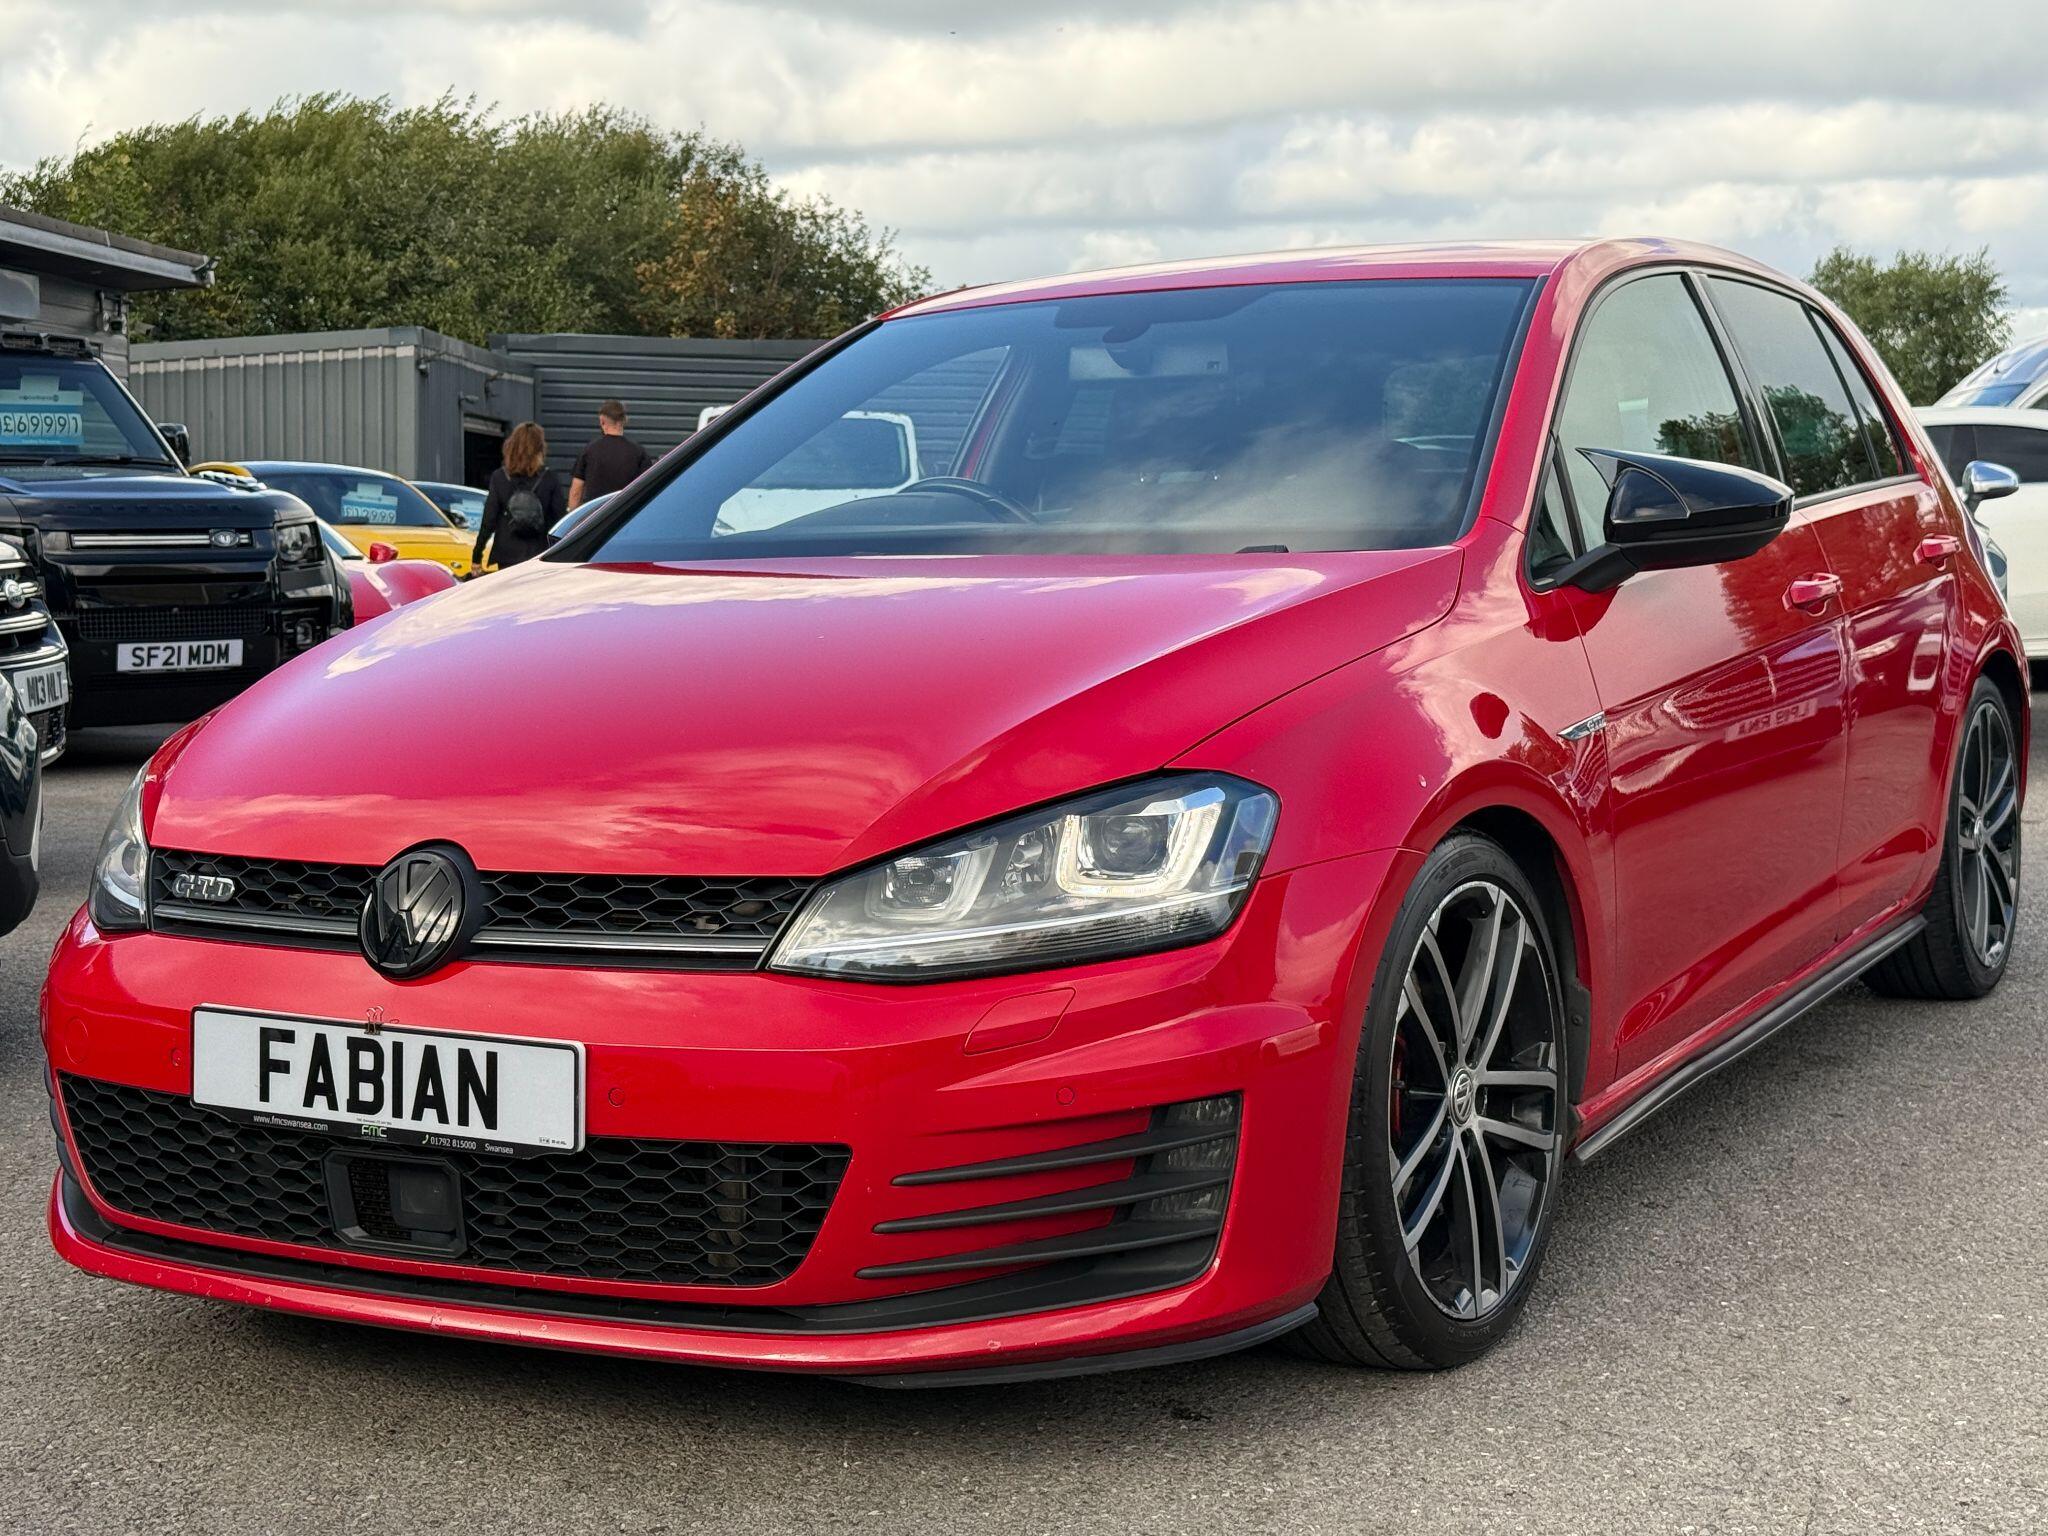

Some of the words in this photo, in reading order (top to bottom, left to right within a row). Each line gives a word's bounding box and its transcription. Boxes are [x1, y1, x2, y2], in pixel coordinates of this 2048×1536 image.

[3, 415, 79, 433] £69991
[131, 645, 182, 667] SF21
[188, 643, 230, 665] MDM
[174, 873, 235, 900] GTD
[259, 1026, 498, 1131] FABIAN
[253, 1114, 329, 1131] www.fmcswansea.com
[430, 1136, 451, 1147] 01792
[452, 1139, 477, 1150] 815000
[484, 1142, 514, 1154] Swansea
